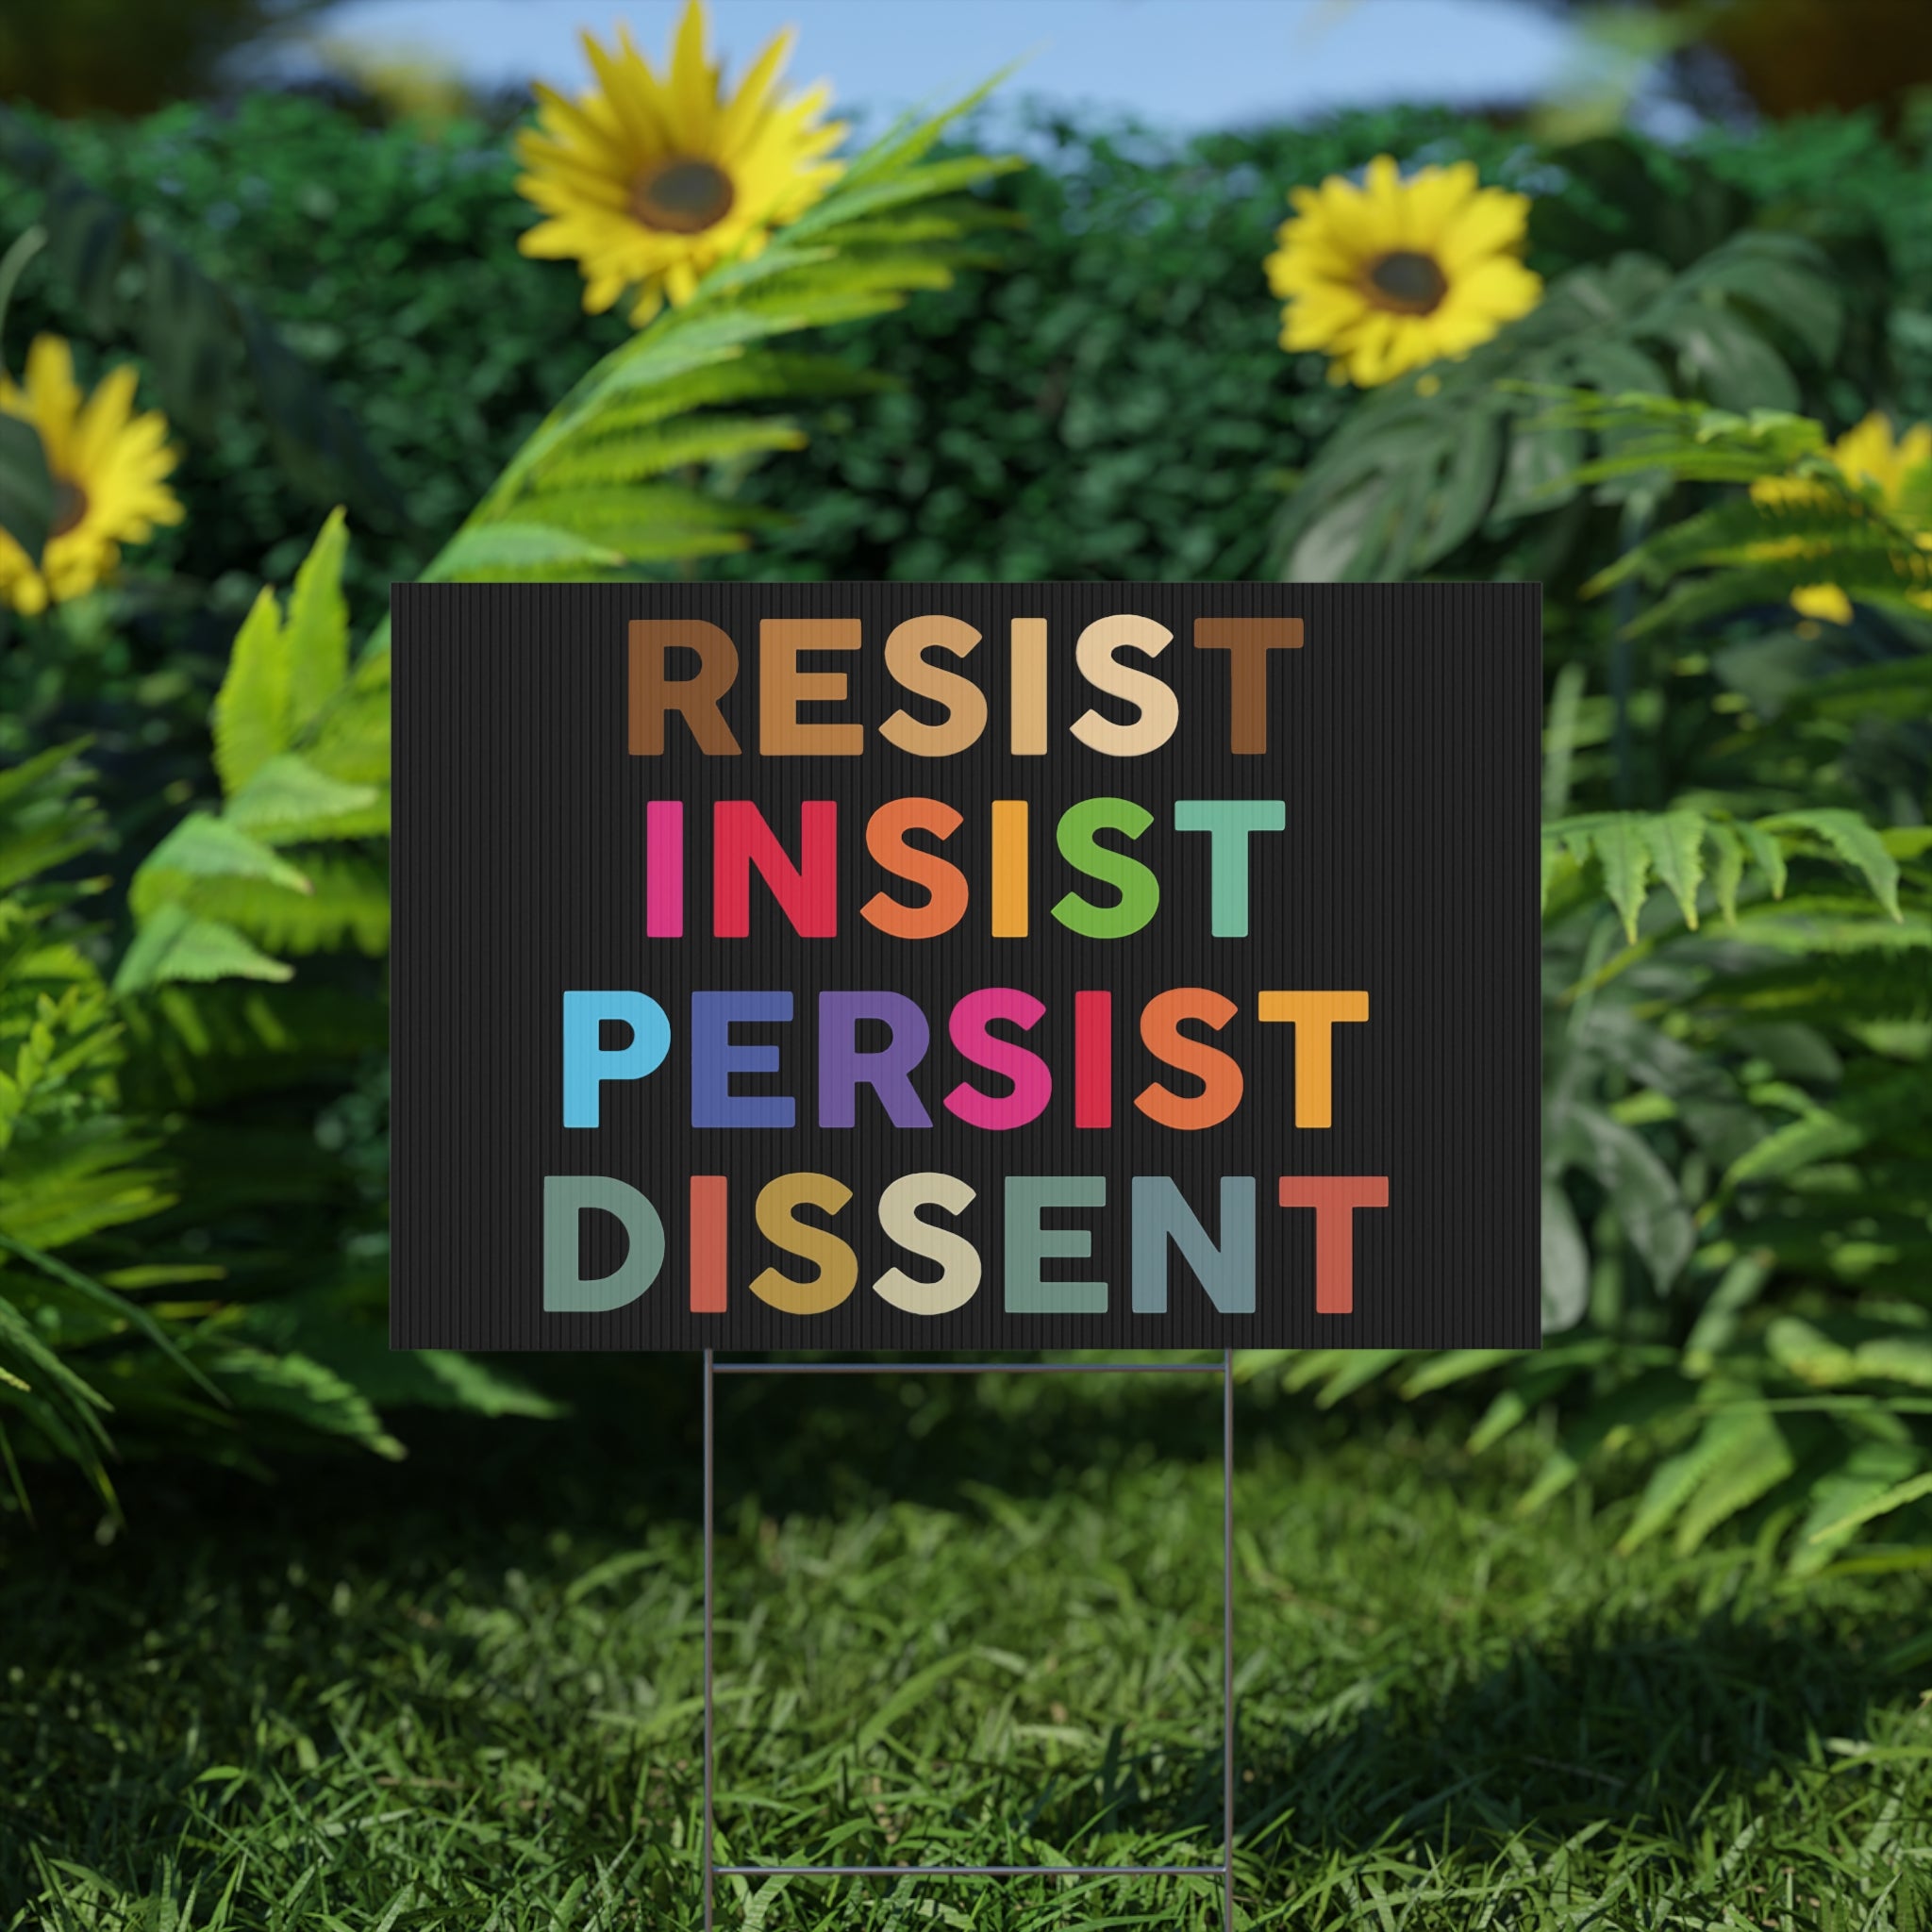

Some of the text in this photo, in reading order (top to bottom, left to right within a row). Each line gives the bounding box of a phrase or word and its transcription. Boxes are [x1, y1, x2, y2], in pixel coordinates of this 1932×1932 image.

[628, 614, 1304, 757] RESIST
[646, 797, 1286, 940] INSIST
[563, 988, 1369, 1130] PERSIST
[543, 1173, 1389, 1315] DISSENT
